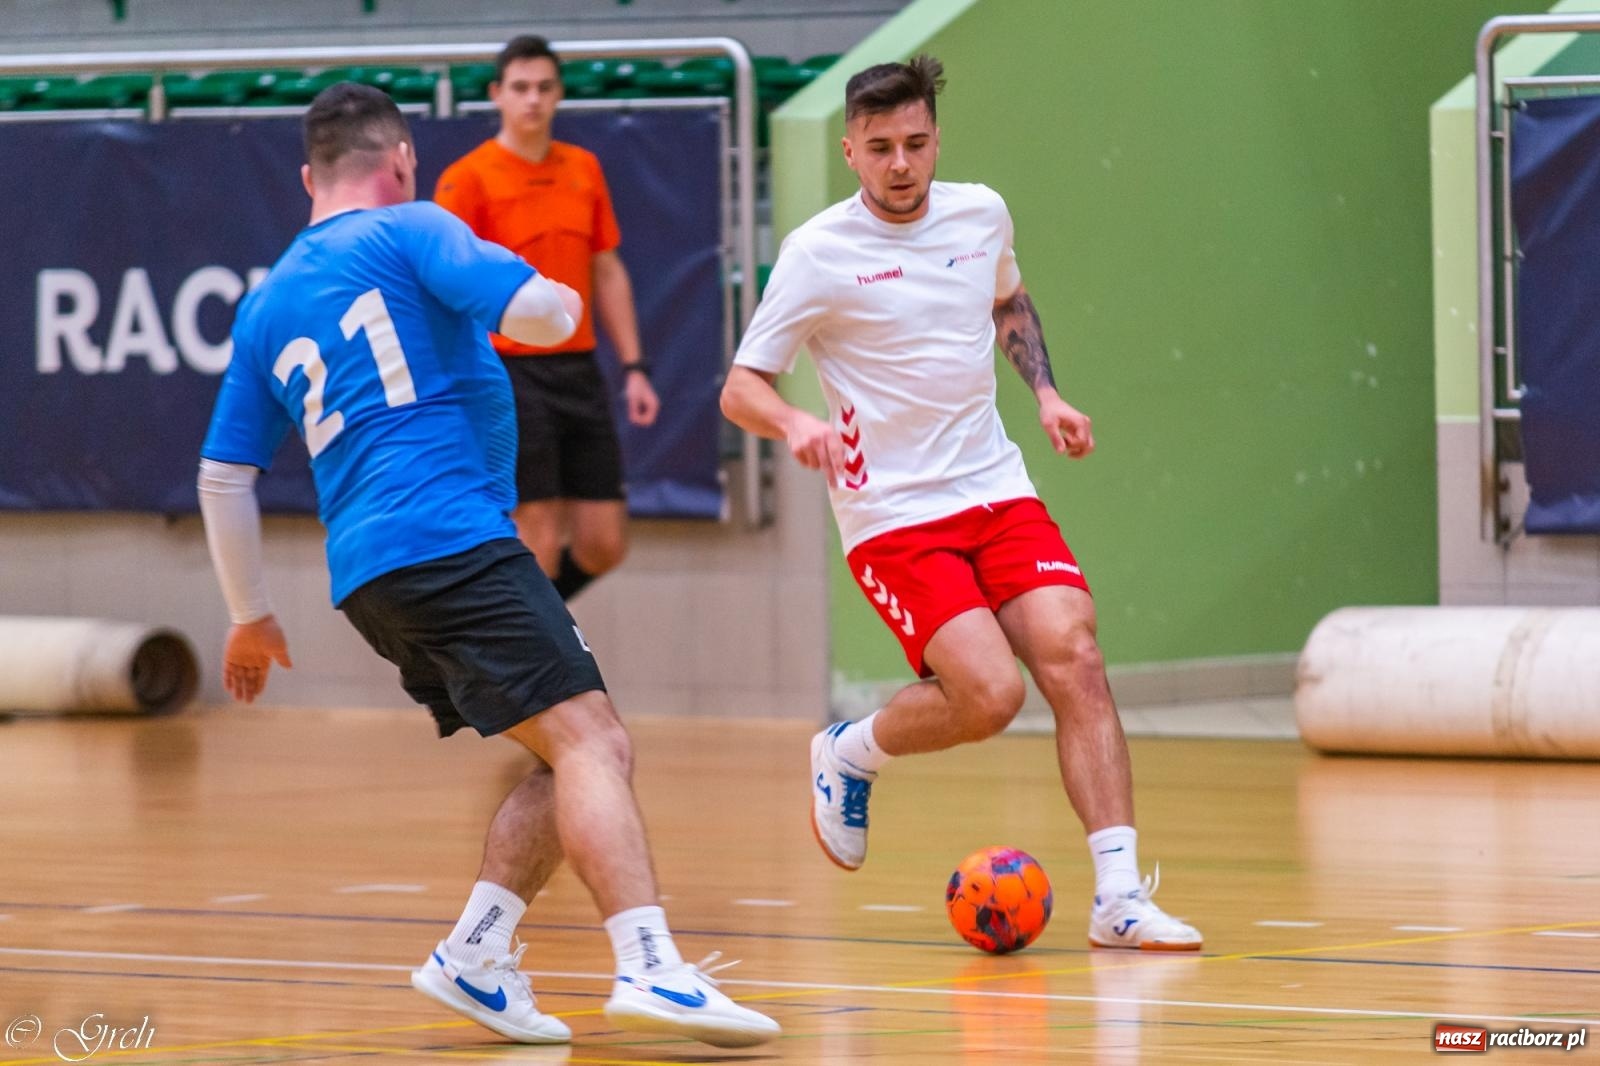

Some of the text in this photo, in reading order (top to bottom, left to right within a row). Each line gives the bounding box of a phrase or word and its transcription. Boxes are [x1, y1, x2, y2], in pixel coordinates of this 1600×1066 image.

[36, 265, 270, 374] RAC
[857, 266, 903, 286] hummel
[272, 287, 417, 459] 21
